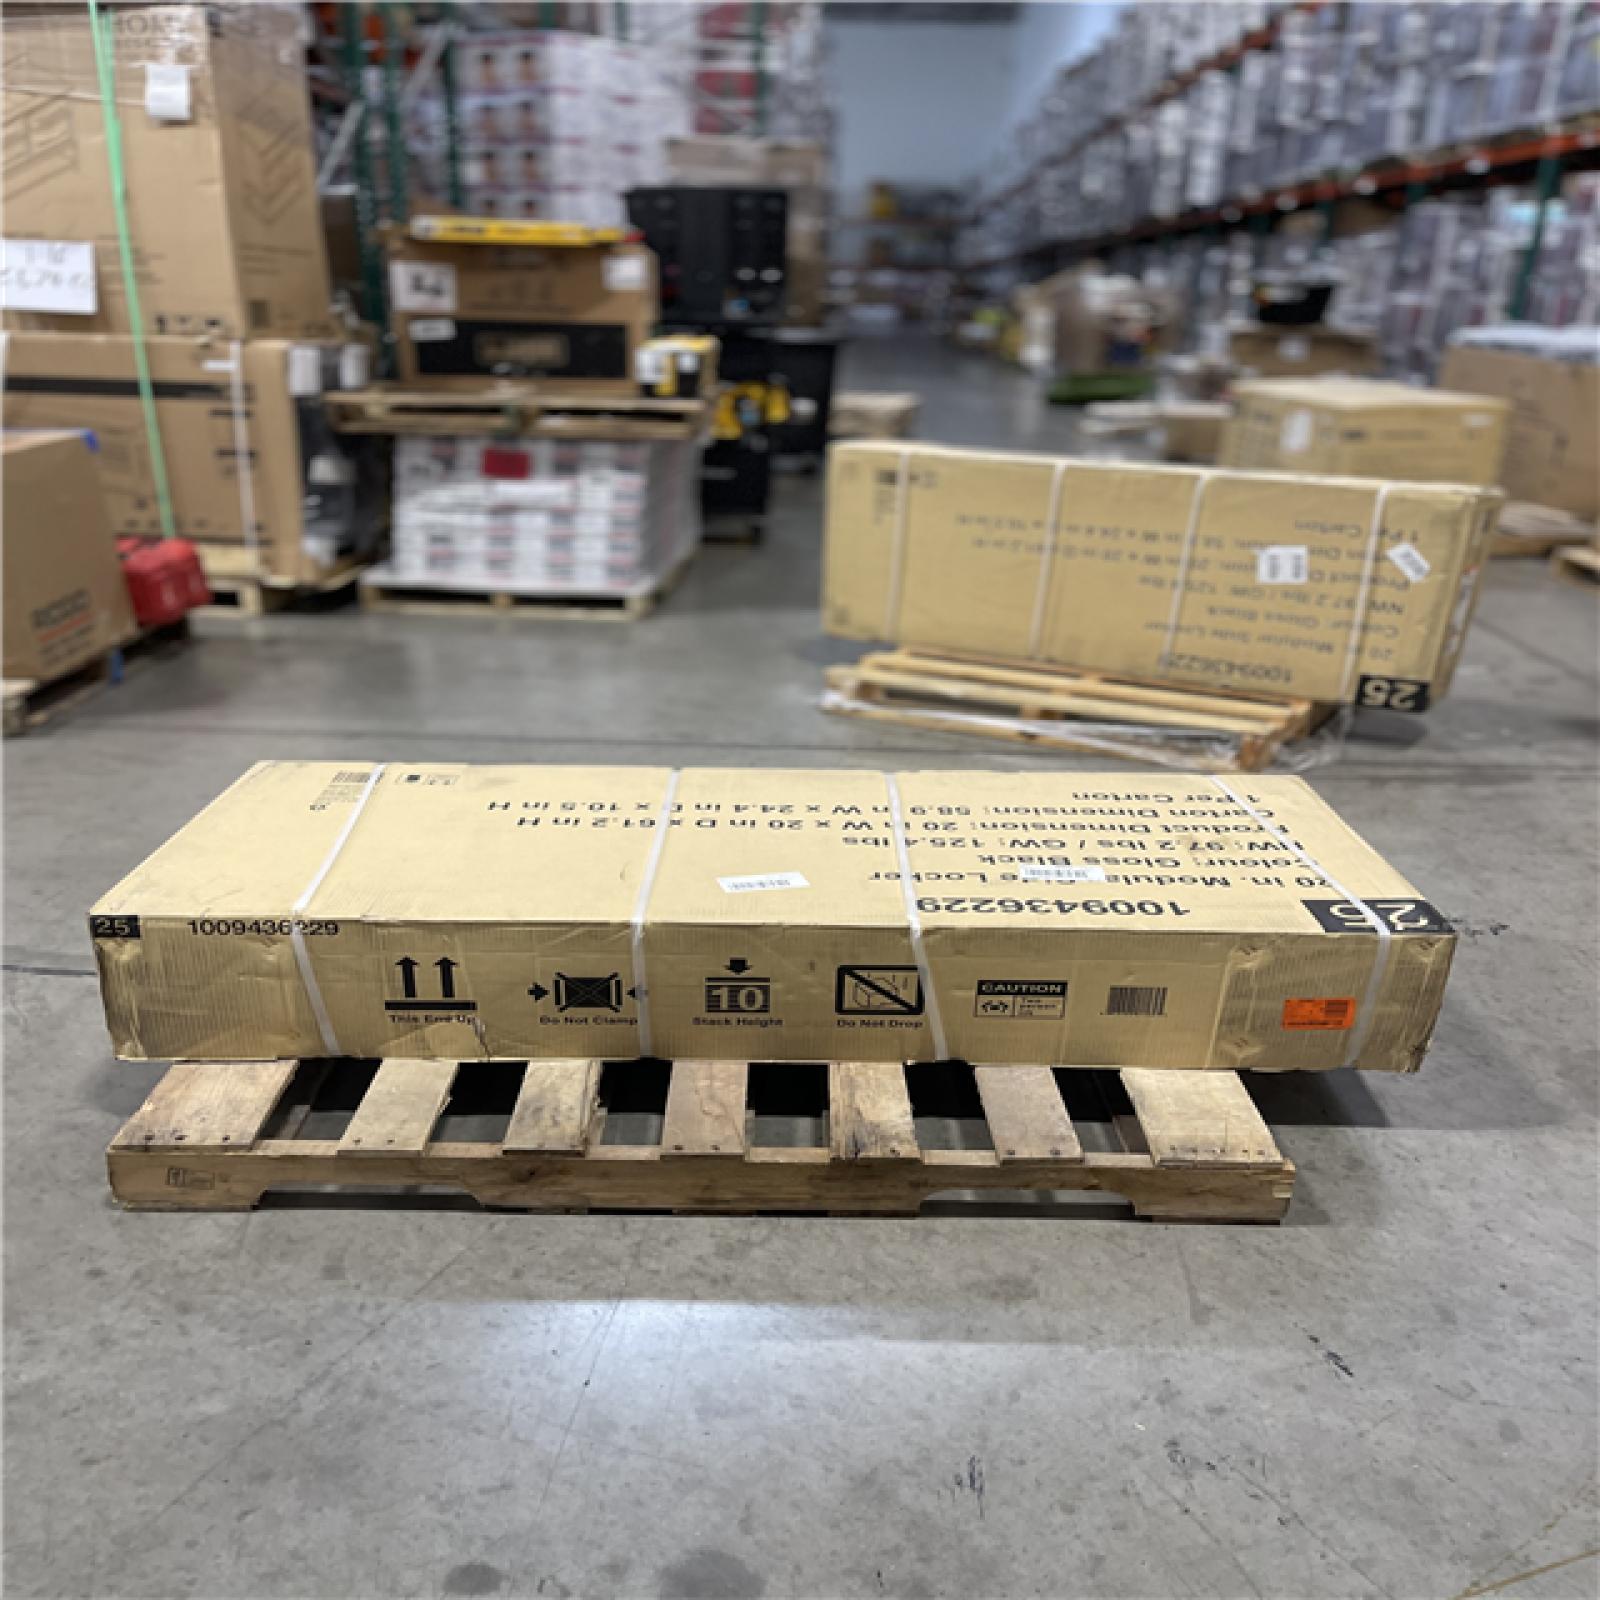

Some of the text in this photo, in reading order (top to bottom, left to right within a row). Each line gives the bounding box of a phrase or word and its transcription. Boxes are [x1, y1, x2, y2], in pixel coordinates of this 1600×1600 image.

[1363, 679, 1420, 711] 25
[1072, 792, 1174, 804] Carton
[1185, 794, 1236, 804] Per
[488, 801, 511, 811] H
[832, 804, 861, 815] W
[517, 817, 541, 827] H
[552, 817, 581, 827] in
[695, 818, 717, 829] D
[729, 819, 756, 829] in
[769, 819, 803, 830] 20
[842, 820, 873, 831] W
[922, 821, 958, 831] 20
[841, 837, 890, 848] lbs
[1096, 839, 1147, 851] lbs
[1159, 839, 1225, 851] 97.2
[977, 855, 1072, 867] Black
[1082, 856, 1181, 868] Gloss
[1105, 875, 1231, 888] Modula
[915, 897, 1191, 916] 1009436229
[1328, 903, 1430, 931] 25
[95, 918, 133, 936] 25
[981, 983, 1062, 994] CAUTION
[711, 986, 763, 1010] 10
[539, 1016, 560, 1026] Do
[563, 1016, 588, 1026] Not
[692, 1016, 784, 1028] Stack Height
[836, 1019, 924, 1030] Do Not Drop
